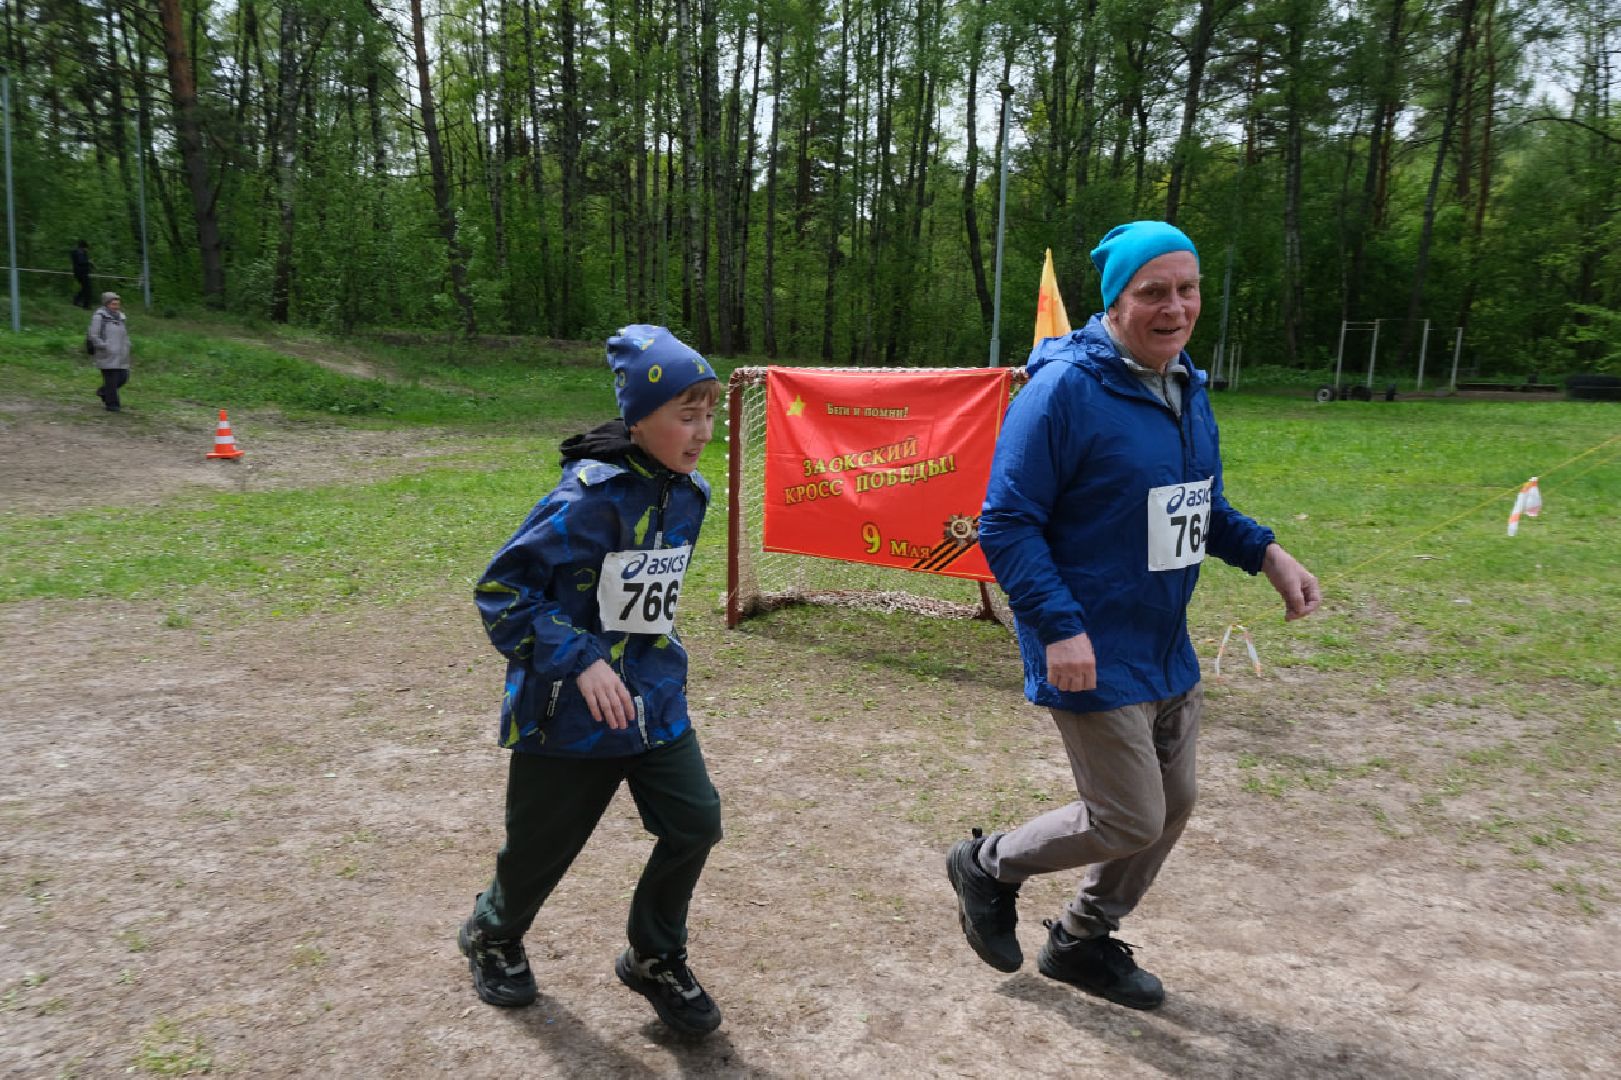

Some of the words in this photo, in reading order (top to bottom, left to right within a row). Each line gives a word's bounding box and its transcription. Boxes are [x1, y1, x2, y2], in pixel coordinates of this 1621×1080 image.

[803, 437, 917, 477] ЗАОКСКИЙ
[785, 479, 844, 505] КРОСС
[855, 454, 956, 493] ПОБЕДЫ!
[862, 521, 881, 555] 9
[647, 555, 685, 575] asics
[619, 579, 679, 622] 766
